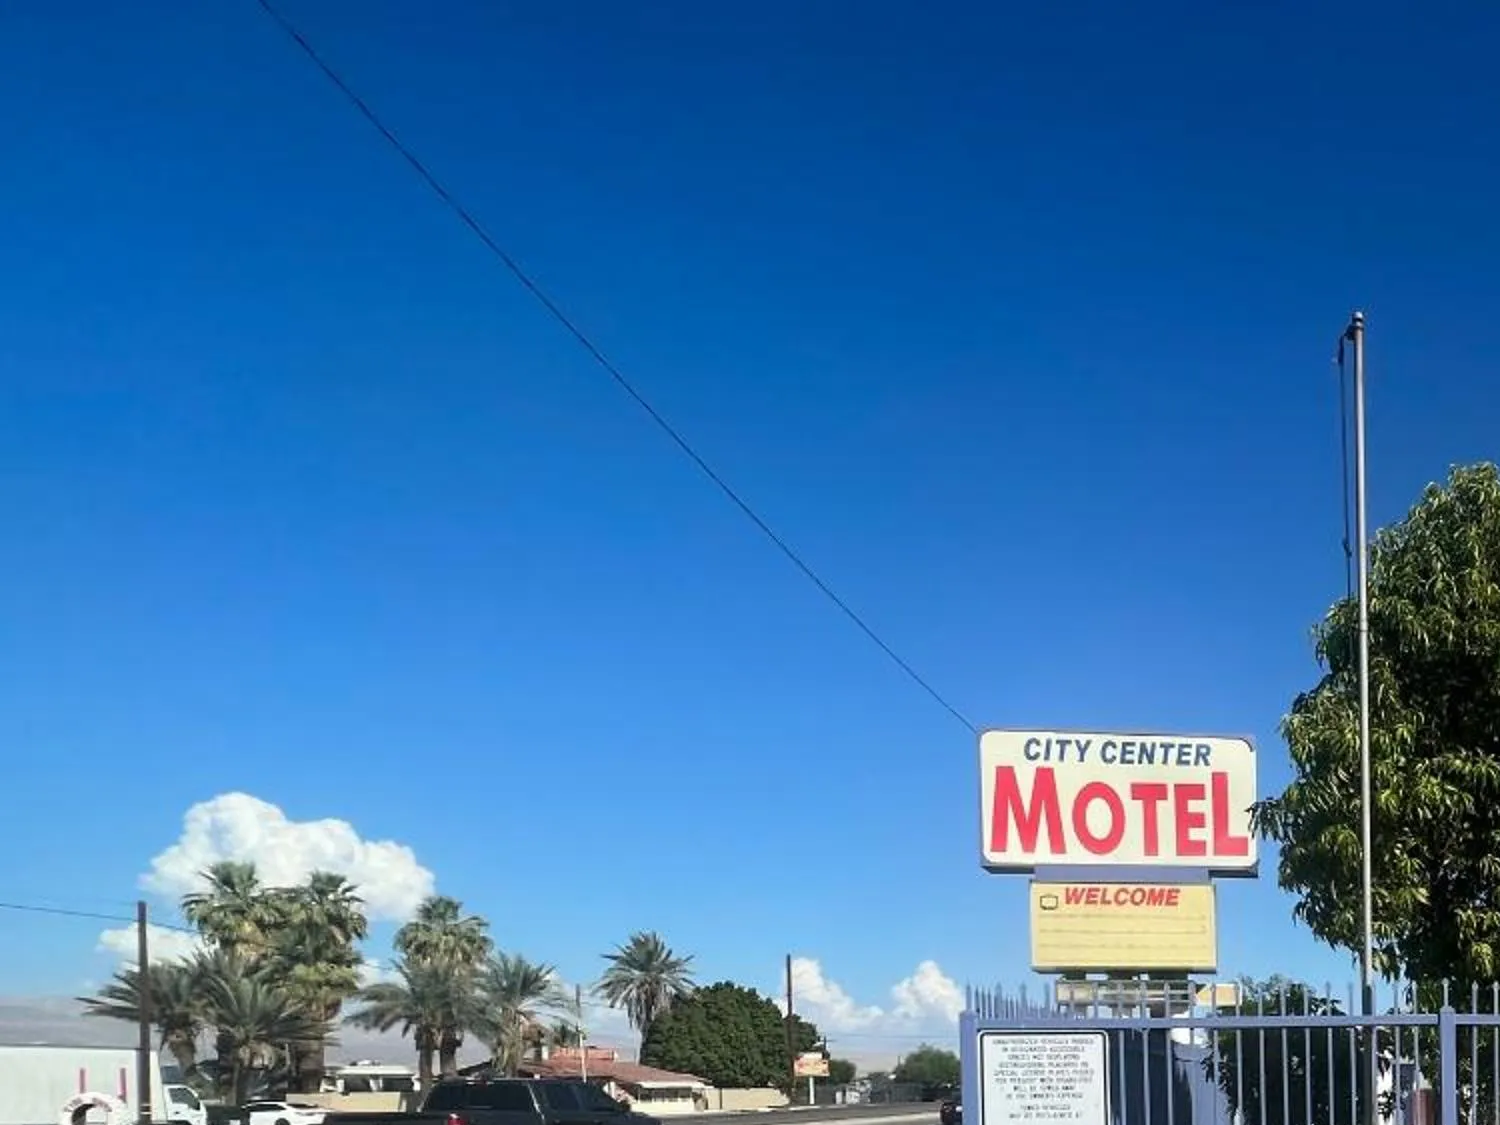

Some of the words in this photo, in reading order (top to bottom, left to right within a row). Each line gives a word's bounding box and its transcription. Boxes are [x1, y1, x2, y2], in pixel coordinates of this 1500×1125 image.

[1024, 738, 1092, 763] CITY
[1100, 742, 1211, 766] CENTER
[990, 765, 1249, 857] MOTEL
[1064, 887, 1181, 907] WELCOME
